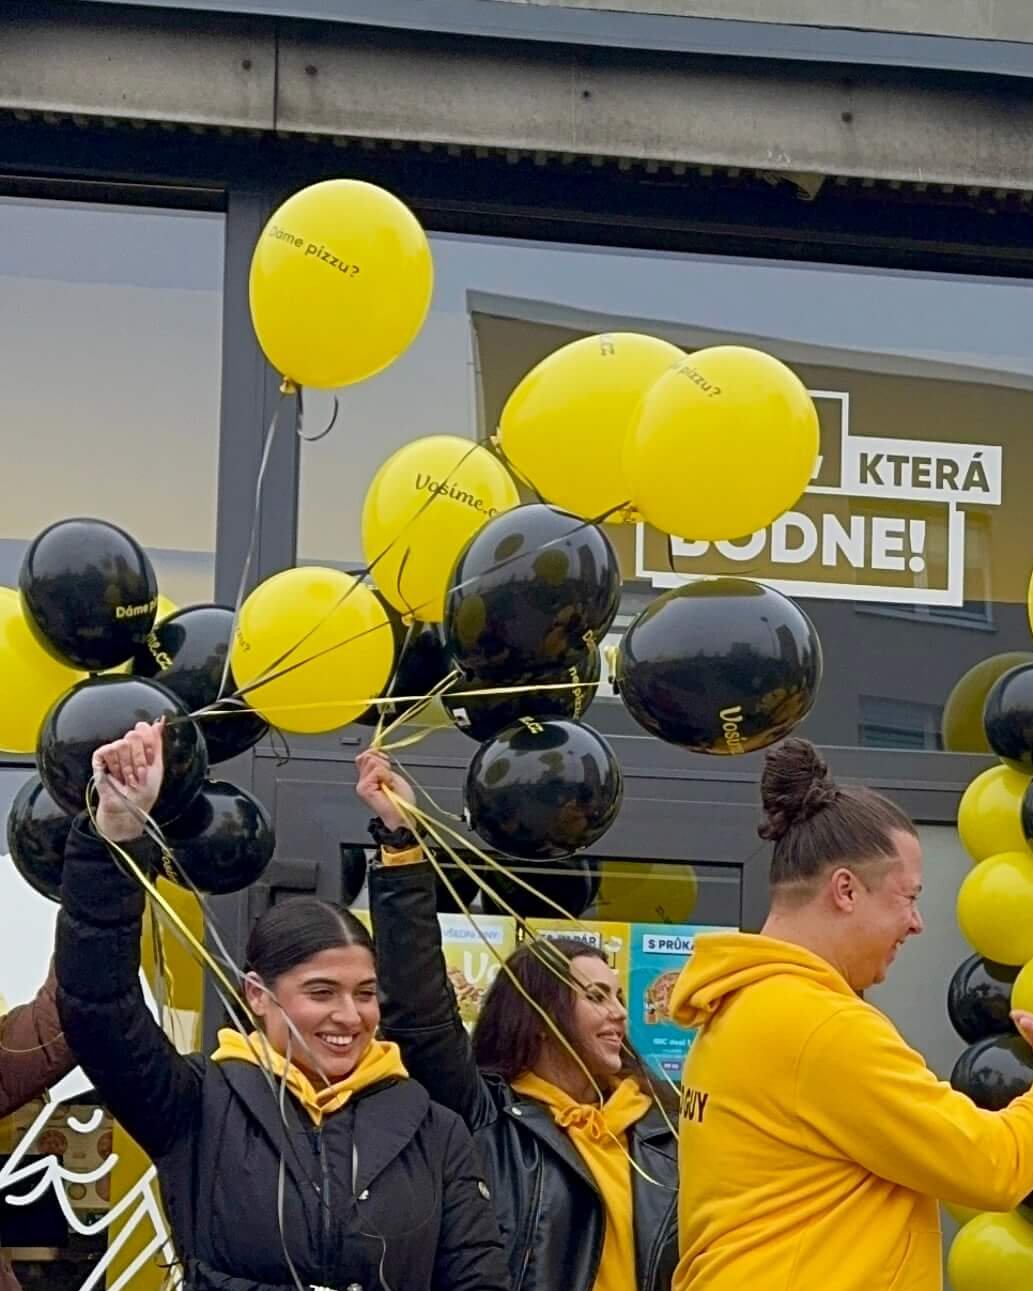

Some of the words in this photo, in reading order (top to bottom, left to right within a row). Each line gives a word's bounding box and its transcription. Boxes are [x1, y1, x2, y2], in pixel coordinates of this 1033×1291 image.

[304, 244, 360, 278] pizzu?
[859, 451, 991, 493] KTERÁ
[648, 938, 656, 949] S
[658, 934, 696, 951] PRŮK
